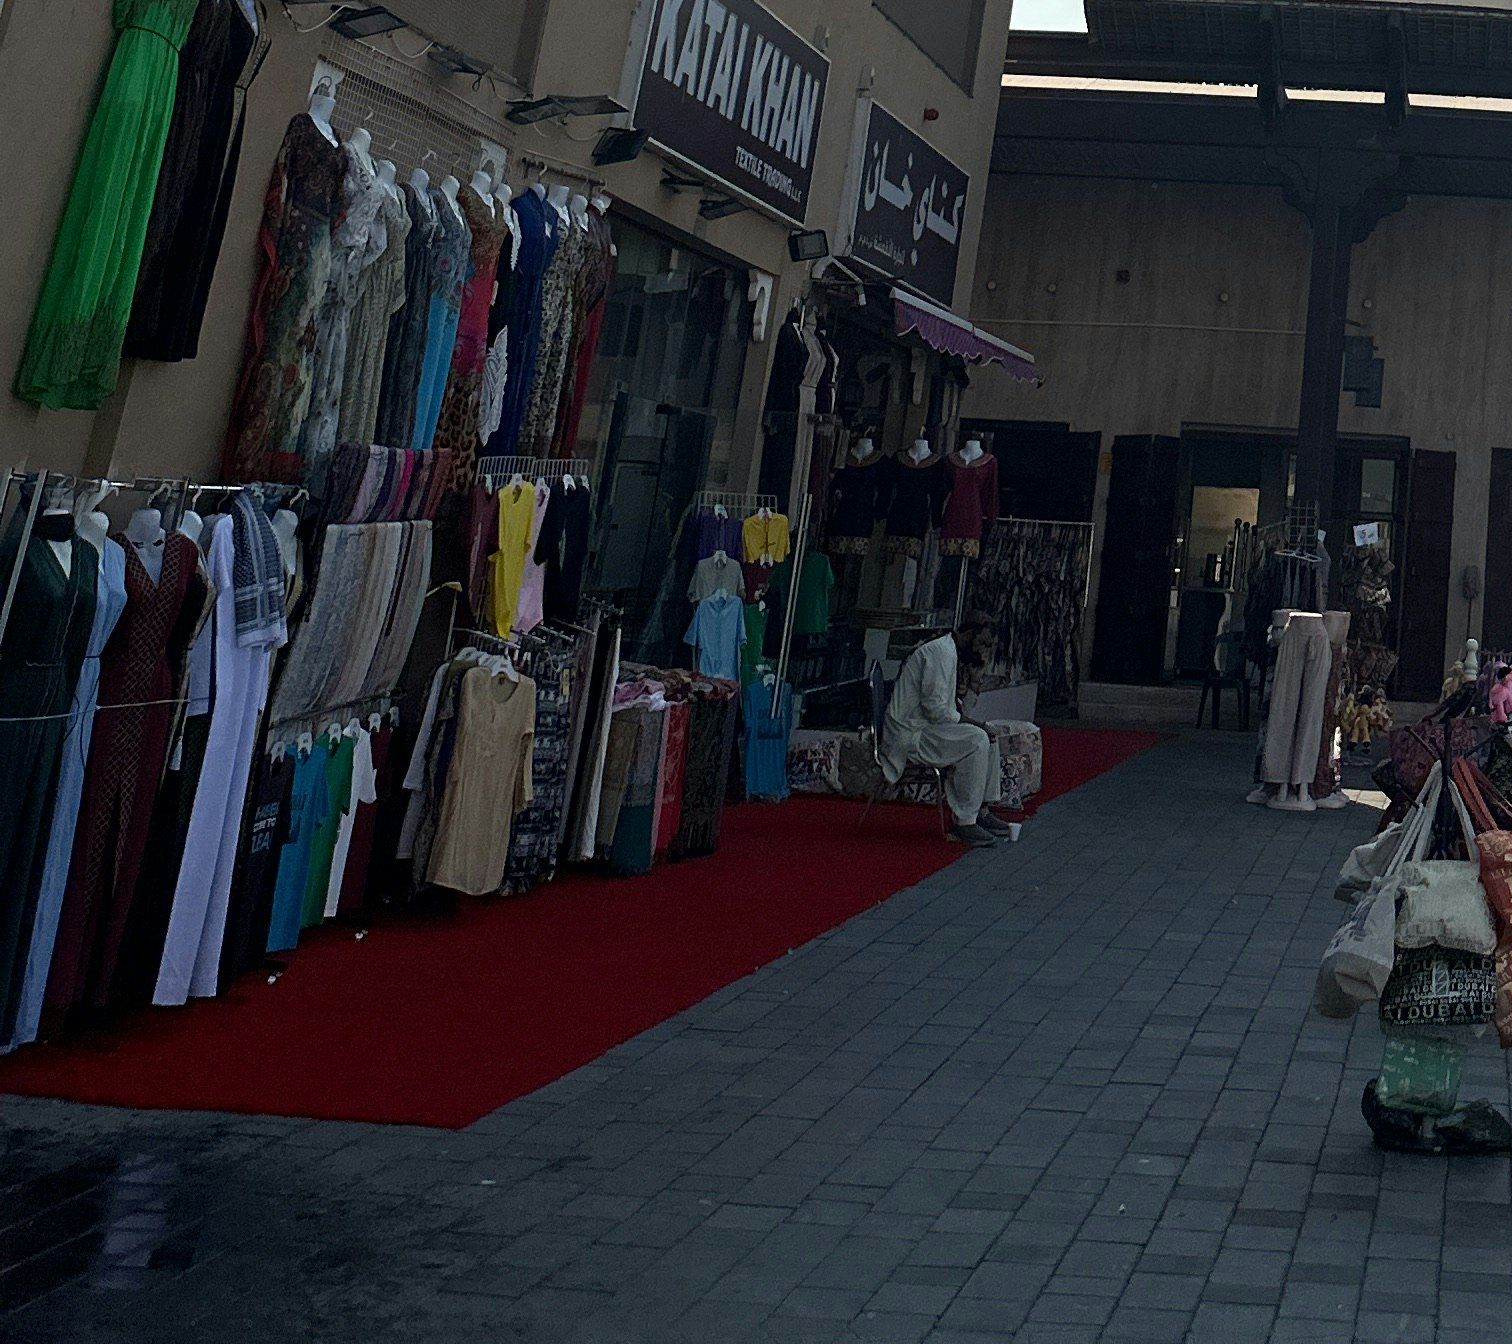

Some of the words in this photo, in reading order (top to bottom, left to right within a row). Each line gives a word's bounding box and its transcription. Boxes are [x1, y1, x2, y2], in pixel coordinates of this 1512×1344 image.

[741, 33, 821, 170] KHAN
[735, 145, 763, 179] TEXTILE
[864, 139, 914, 212] خان
